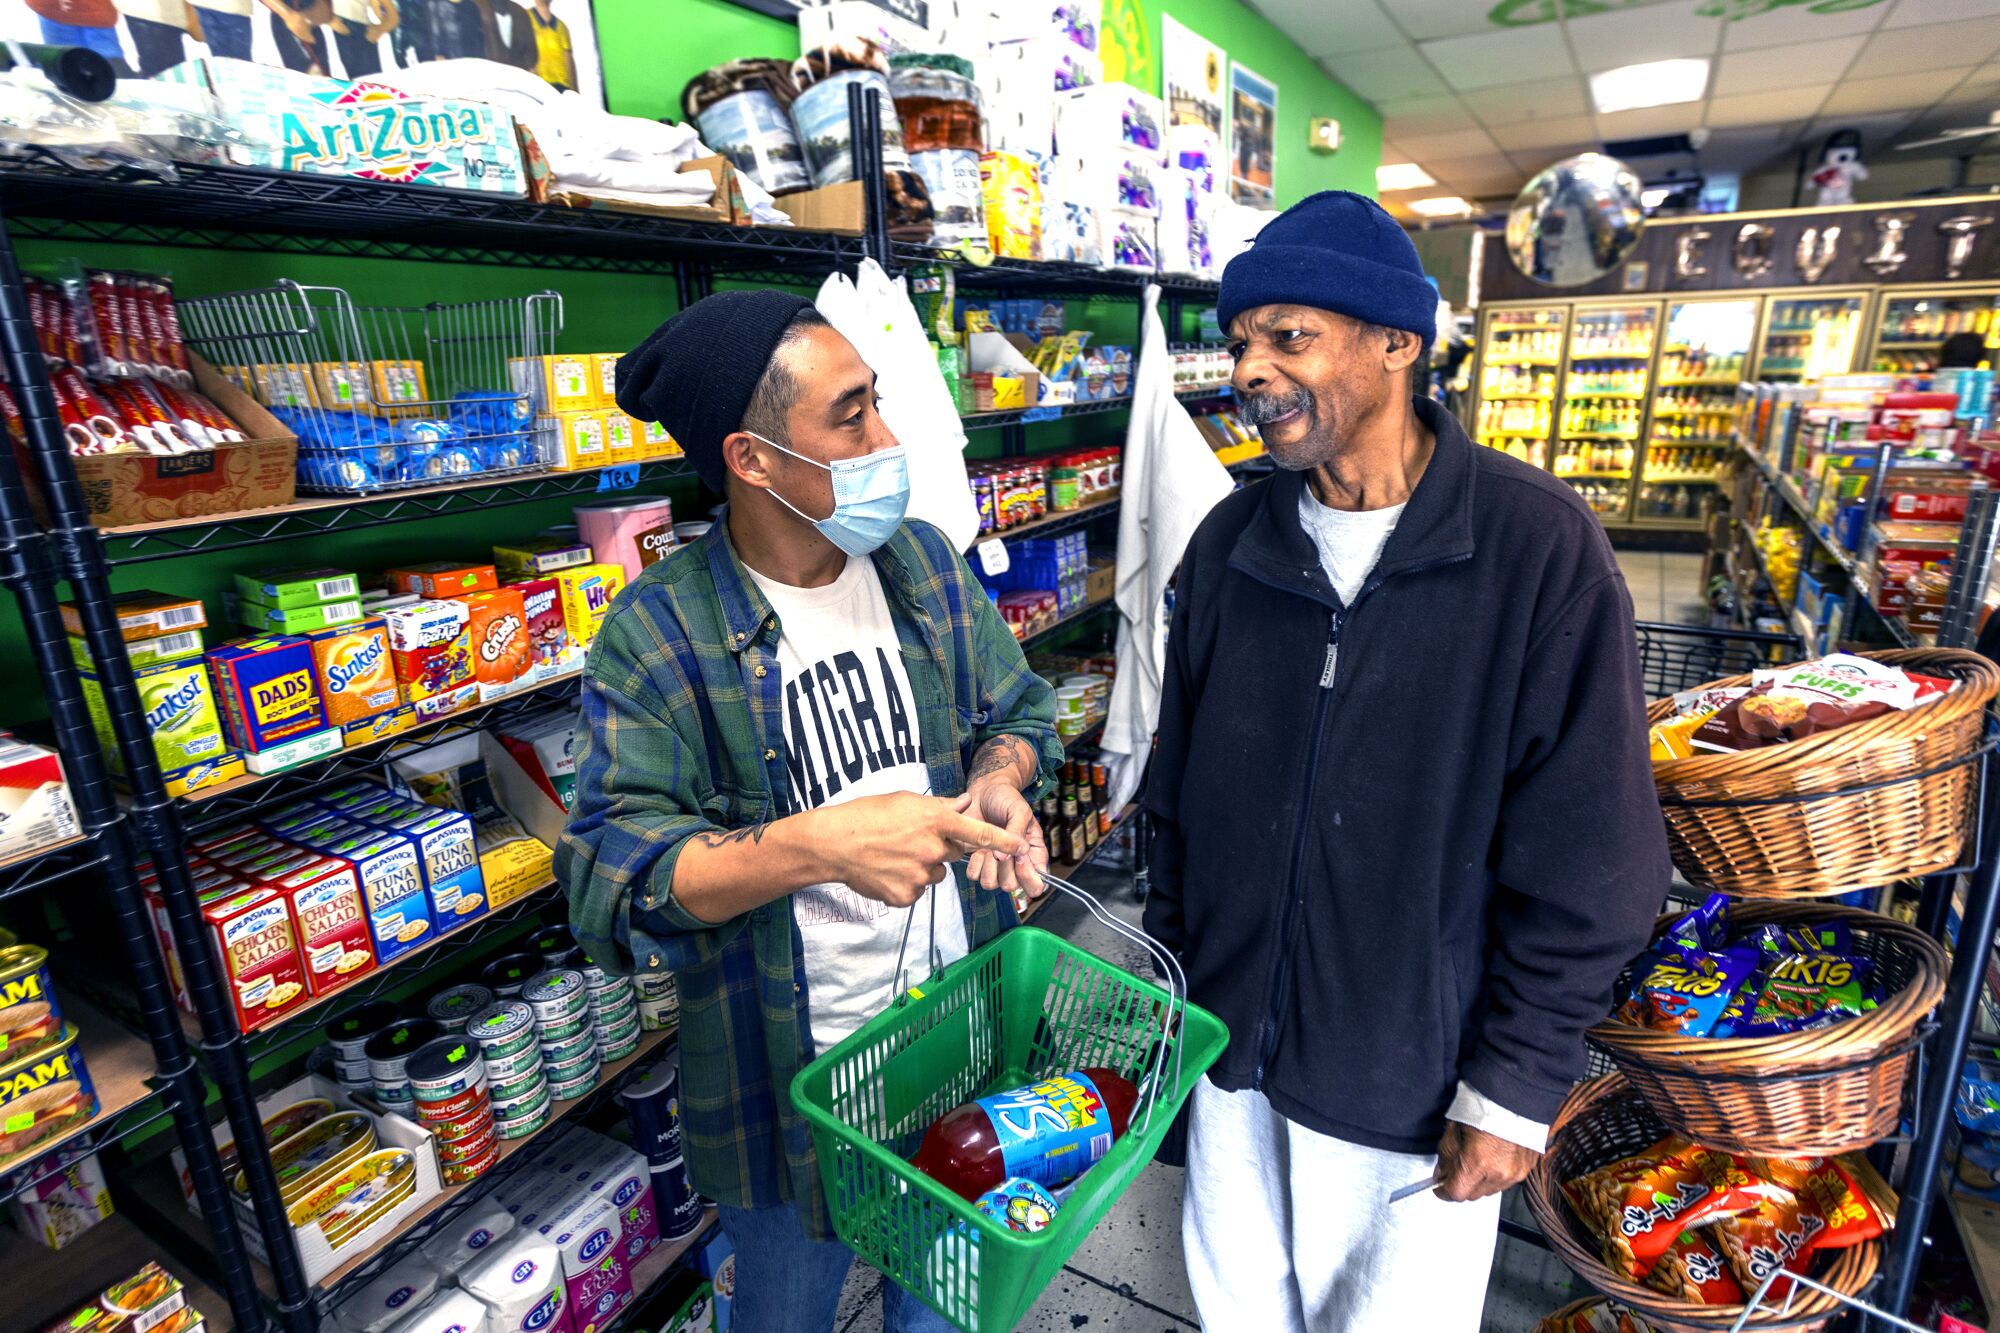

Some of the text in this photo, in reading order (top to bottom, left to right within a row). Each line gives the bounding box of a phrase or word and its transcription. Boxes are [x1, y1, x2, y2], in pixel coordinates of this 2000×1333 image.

[282, 106, 482, 171] AriZona
[464, 157, 486, 178] NO
[642, 531, 675, 551] Coun
[481, 615, 522, 662] Crush
[328, 633, 384, 693] Sunkist
[258, 675, 308, 709] DAD'S
[1791, 673, 1865, 698] PUFFS
[266, 699, 308, 720] ROOT BEER
[785, 647, 925, 815] MIGRA
[425, 826, 470, 851] BRUNSWICK
[365, 851, 414, 878] BRUNSWICK
[431, 843, 469, 866] TUNA
[432, 853, 473, 879] SALAD
[298, 876, 352, 908] BRUNSWICK
[373, 868, 414, 893] TUNA
[373, 878, 417, 906] SALAD
[303, 892, 354, 924] CHICKEN
[227, 906, 283, 939] BRUNSWICK
[309, 906, 357, 937] SALAD
[233, 921, 287, 956] CHICKEN
[238, 936, 288, 969] SALAD
[0, 973, 42, 1010] AM
[0, 1055, 71, 1103] PAM
[446, 1099, 470, 1112] Clams
[453, 1112, 483, 1133] Chopped
[508, 1114, 528, 1128] BUMBLE
[509, 1118, 544, 1136] LIGHT TUNA
[657, 1123, 680, 1143] MOR
[453, 1134, 484, 1155] Chopped
[464, 1154, 493, 1175] Chopped
[615, 1180, 637, 1205] C&H
[1821, 1168, 1868, 1221] SHRIMP
[582, 1231, 610, 1261] C&H
[512, 1261, 533, 1282] C&H
